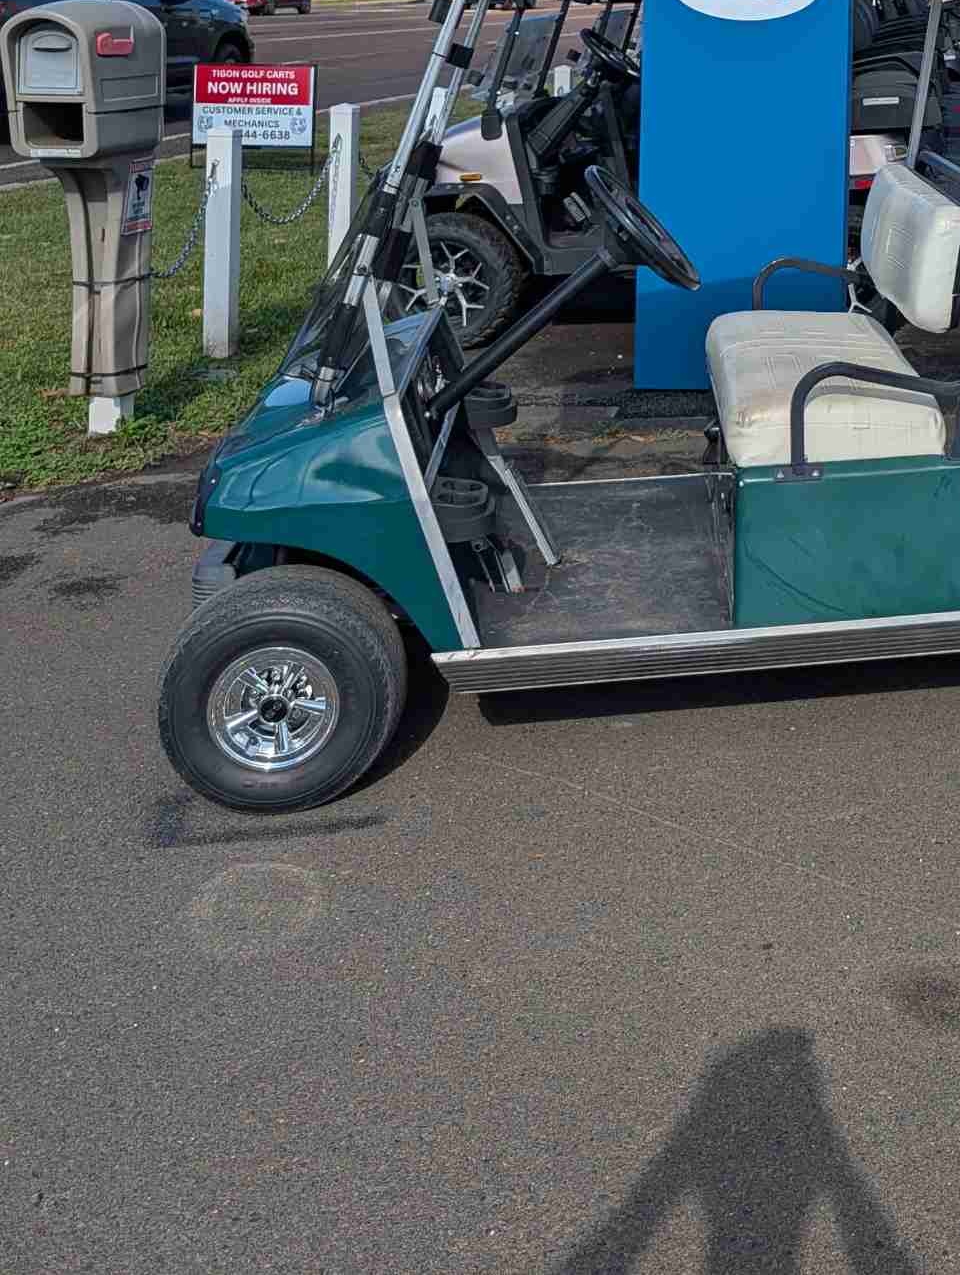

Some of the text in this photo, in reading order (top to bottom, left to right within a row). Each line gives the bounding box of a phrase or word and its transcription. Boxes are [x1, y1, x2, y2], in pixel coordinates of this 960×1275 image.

[211, 69, 296, 79] TIGON GOLF CARTS
[207, 82, 299, 96] NOW HIRING
[202, 106, 254, 115] CUSTOMER
[255, 107, 294, 116] SERVICE
[224, 119, 280, 128] MECHANICS
